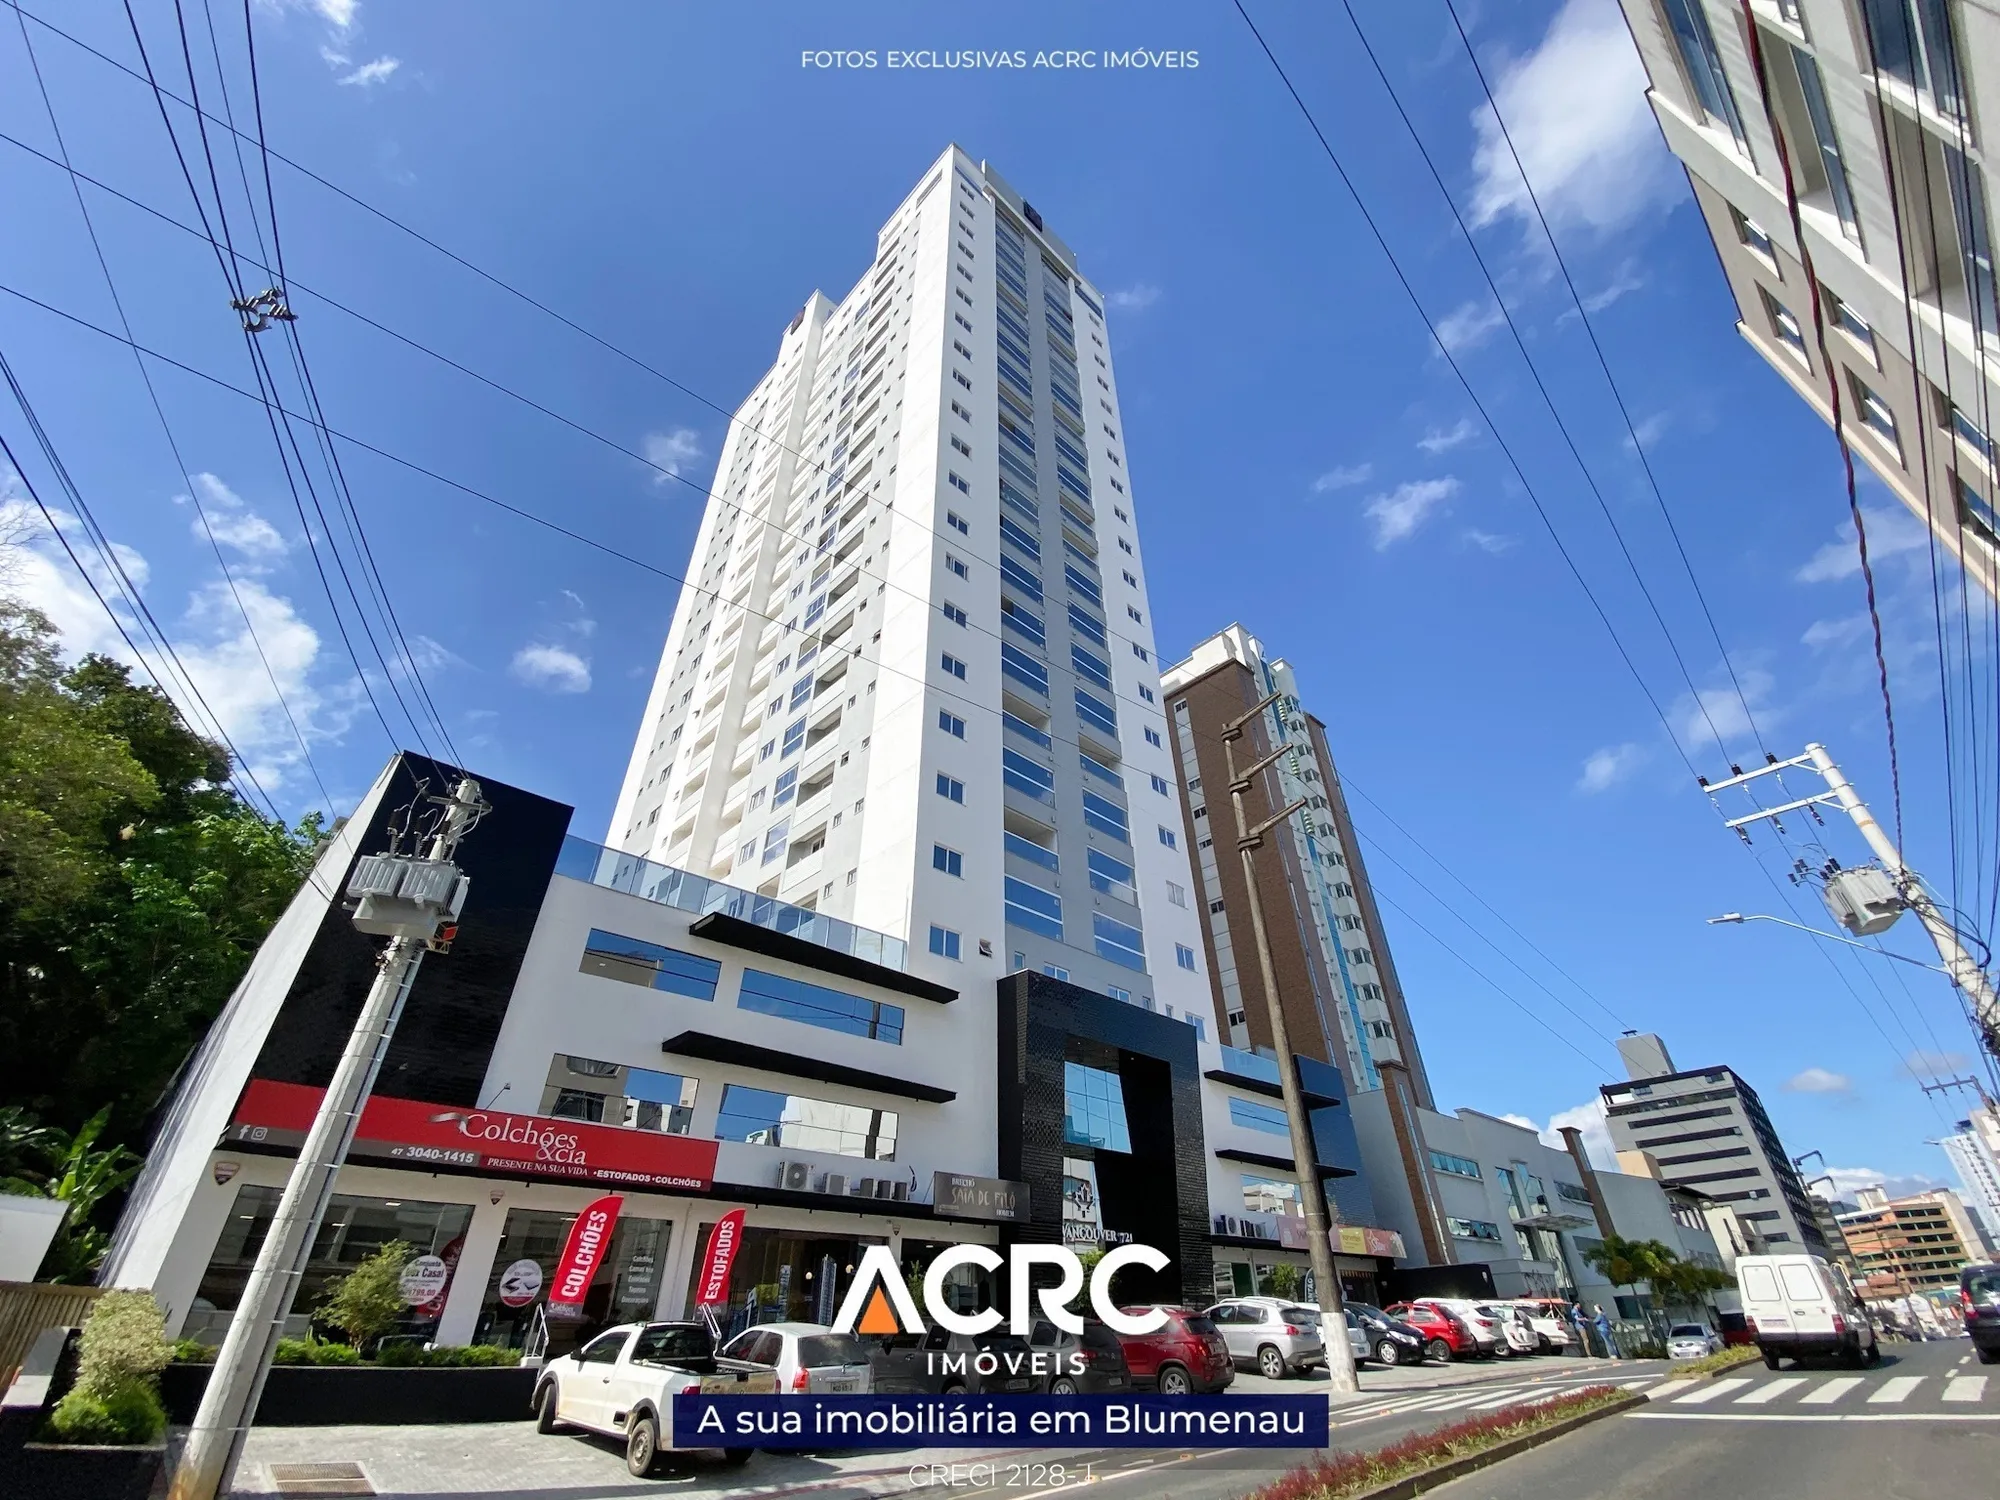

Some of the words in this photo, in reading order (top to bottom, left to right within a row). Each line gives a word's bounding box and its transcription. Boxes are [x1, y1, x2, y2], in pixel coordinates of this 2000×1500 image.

[464, 1113, 579, 1150] Colchões
[391, 1147, 403, 1156] 47
[406, 1146, 475, 1164] 3040-1415
[536, 1140, 587, 1165] &cia
[487, 1157, 532, 1170] PRESENTE
[534, 1163, 547, 1172] NA
[547, 1164, 566, 1174] SUA
[568, 1166, 588, 1176] VIDA
[596, 1169, 651, 1183] ESTOFADOS
[655, 1176, 702, 1188] COLCHÕES
[1062, 1223, 1117, 1242] VANCOUVER
[561, 1210, 608, 1298] COLCHÕES
[704, 1220, 735, 1300] ESTOFADOS
[422, 1267, 445, 1278] Casal
